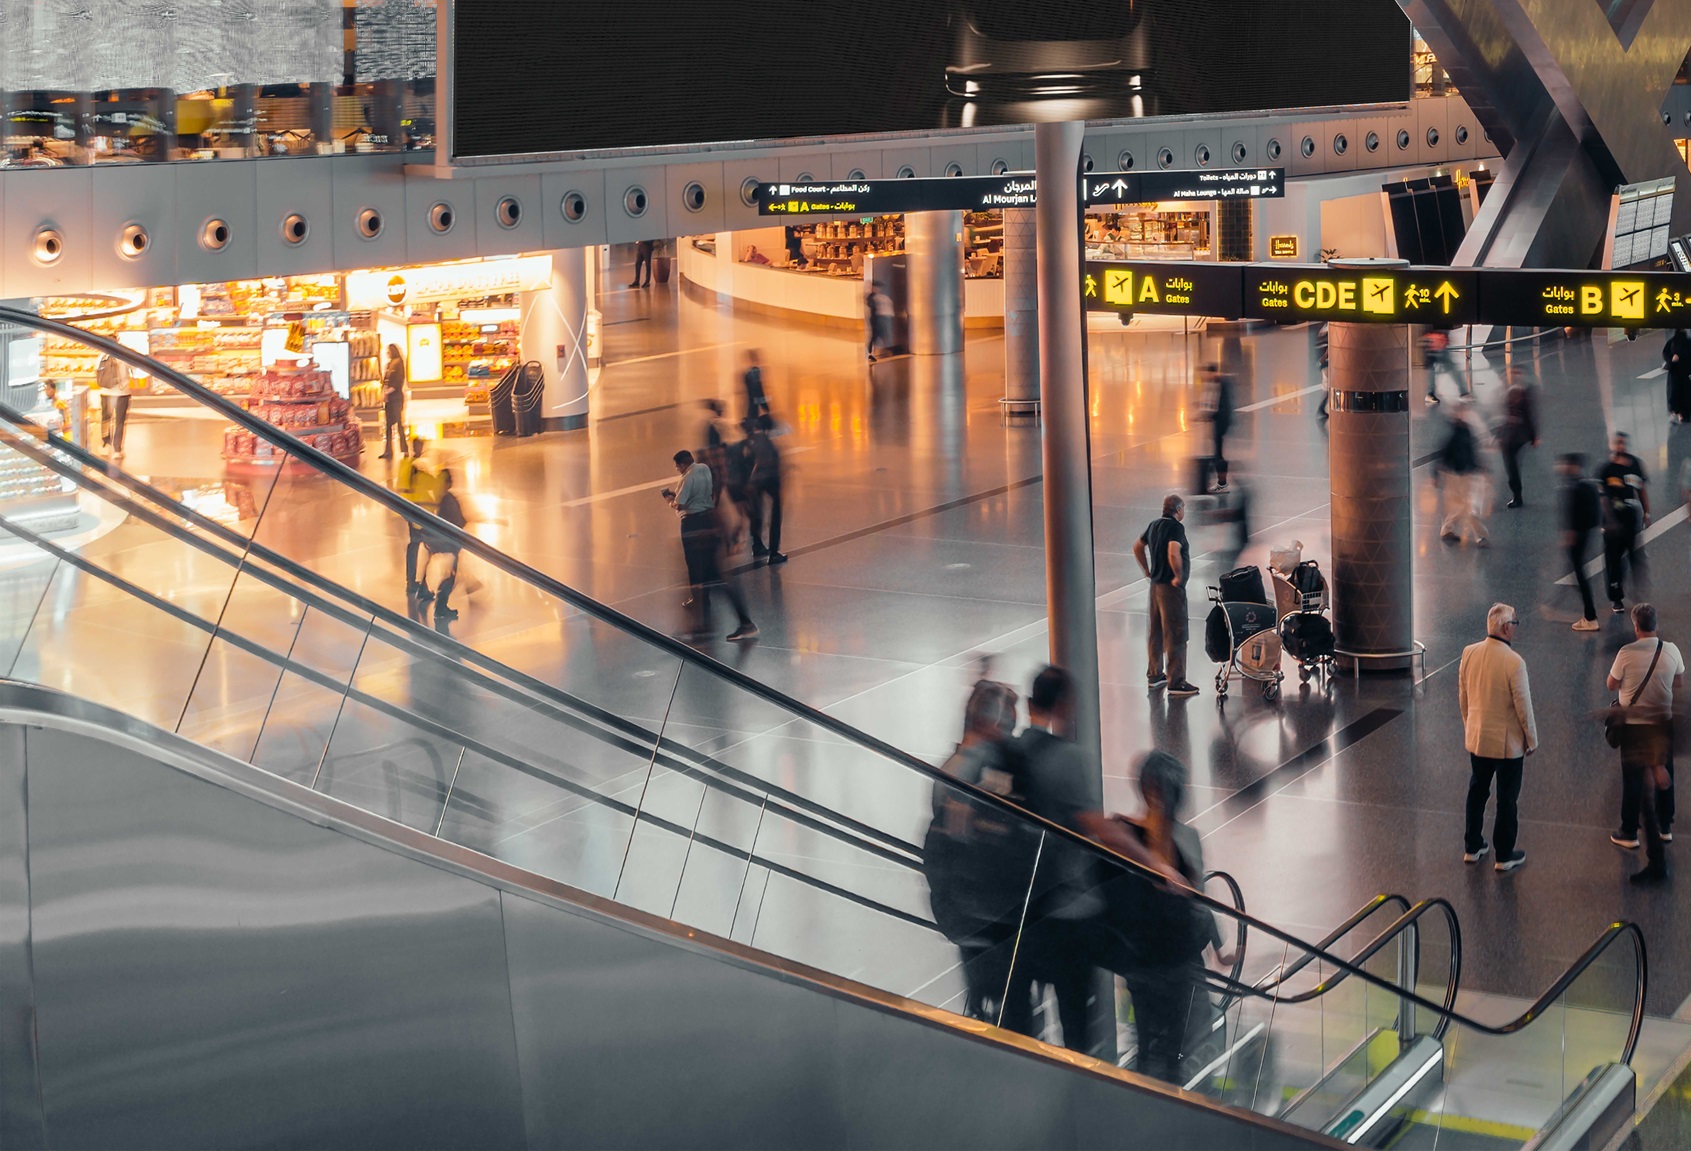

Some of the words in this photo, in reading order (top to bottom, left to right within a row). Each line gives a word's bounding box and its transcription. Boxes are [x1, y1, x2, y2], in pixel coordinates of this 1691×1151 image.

[983, 195, 991, 204] Al
[994, 194, 1028, 205] Mourjan
[800, 202, 809, 212] A
[1139, 276, 1159, 302] A
[1165, 278, 1193, 291] بوابات
[1259, 281, 1288, 294] بوابات
[1294, 281, 1356, 309] CDE
[1419, 288, 1429, 298] 10
[1543, 286, 1575, 300] بوابات
[1673, 293, 1680, 301] 3
[1166, 294, 1190, 304] Gates
[1262, 298, 1288, 307] Gates
[1581, 286, 1603, 314] B
[1546, 304, 1574, 314] Gates
